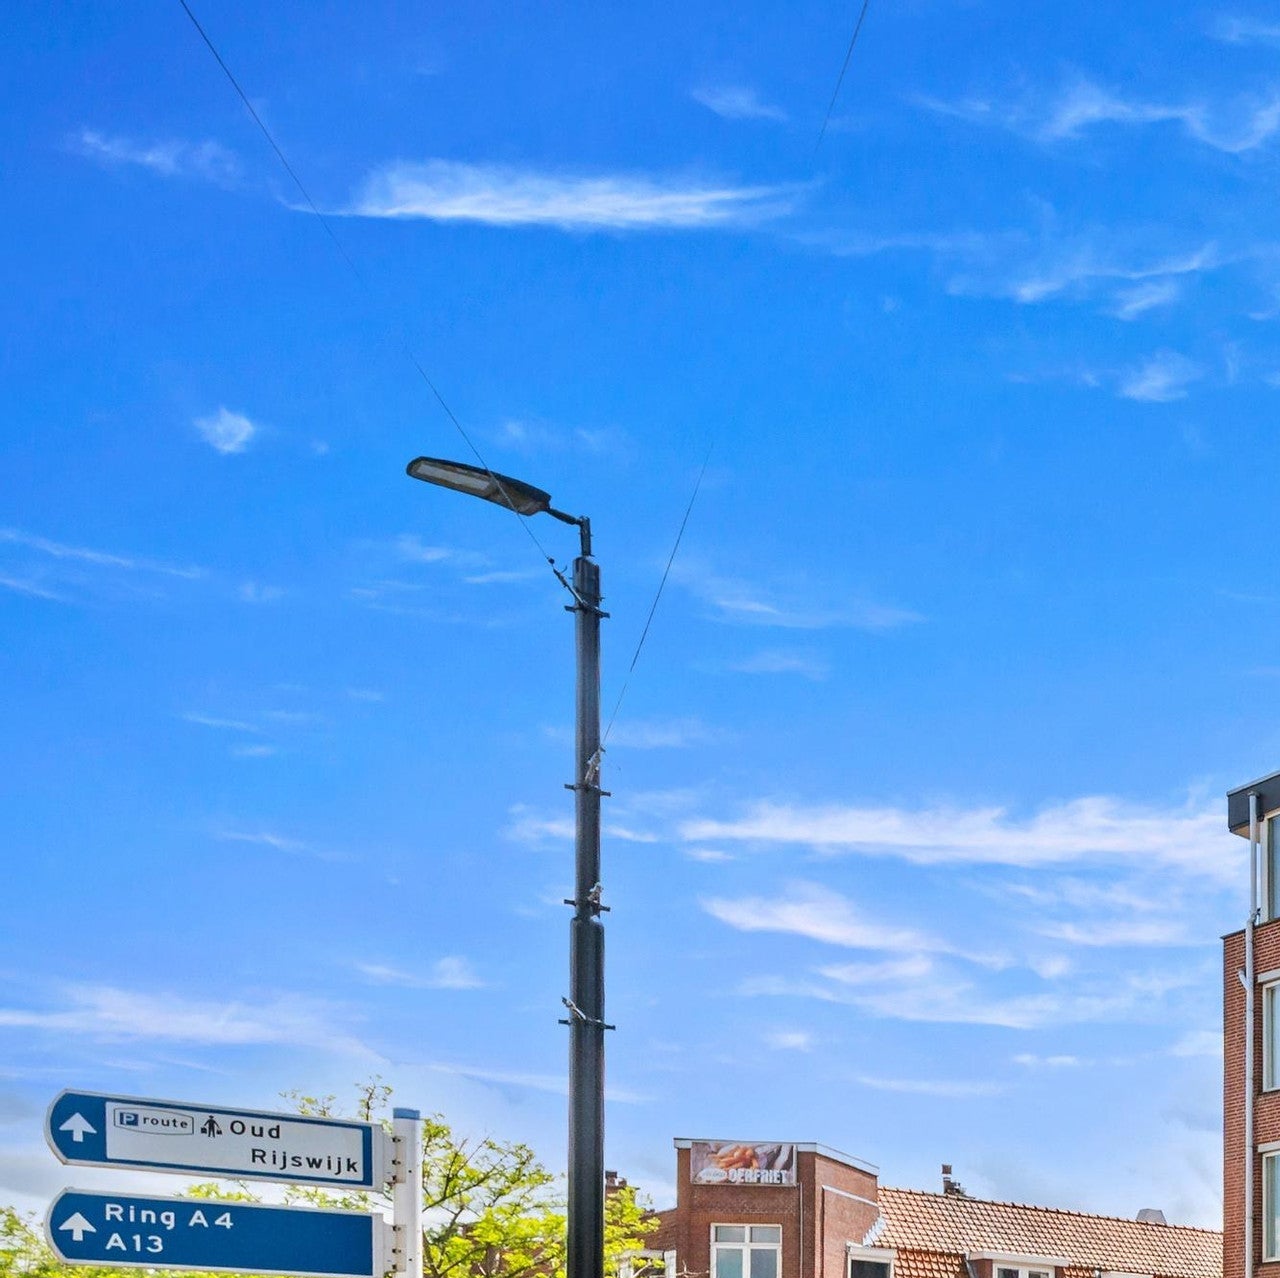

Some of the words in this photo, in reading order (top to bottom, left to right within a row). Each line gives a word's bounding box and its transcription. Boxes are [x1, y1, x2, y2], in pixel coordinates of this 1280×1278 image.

[142, 1116, 189, 1129] route
[230, 1119, 281, 1139] Oud
[251, 1148, 359, 1175] Rijswijk
[105, 1204, 175, 1228] Ring
[189, 1210, 234, 1229] A4
[105, 1234, 164, 1253] A13
